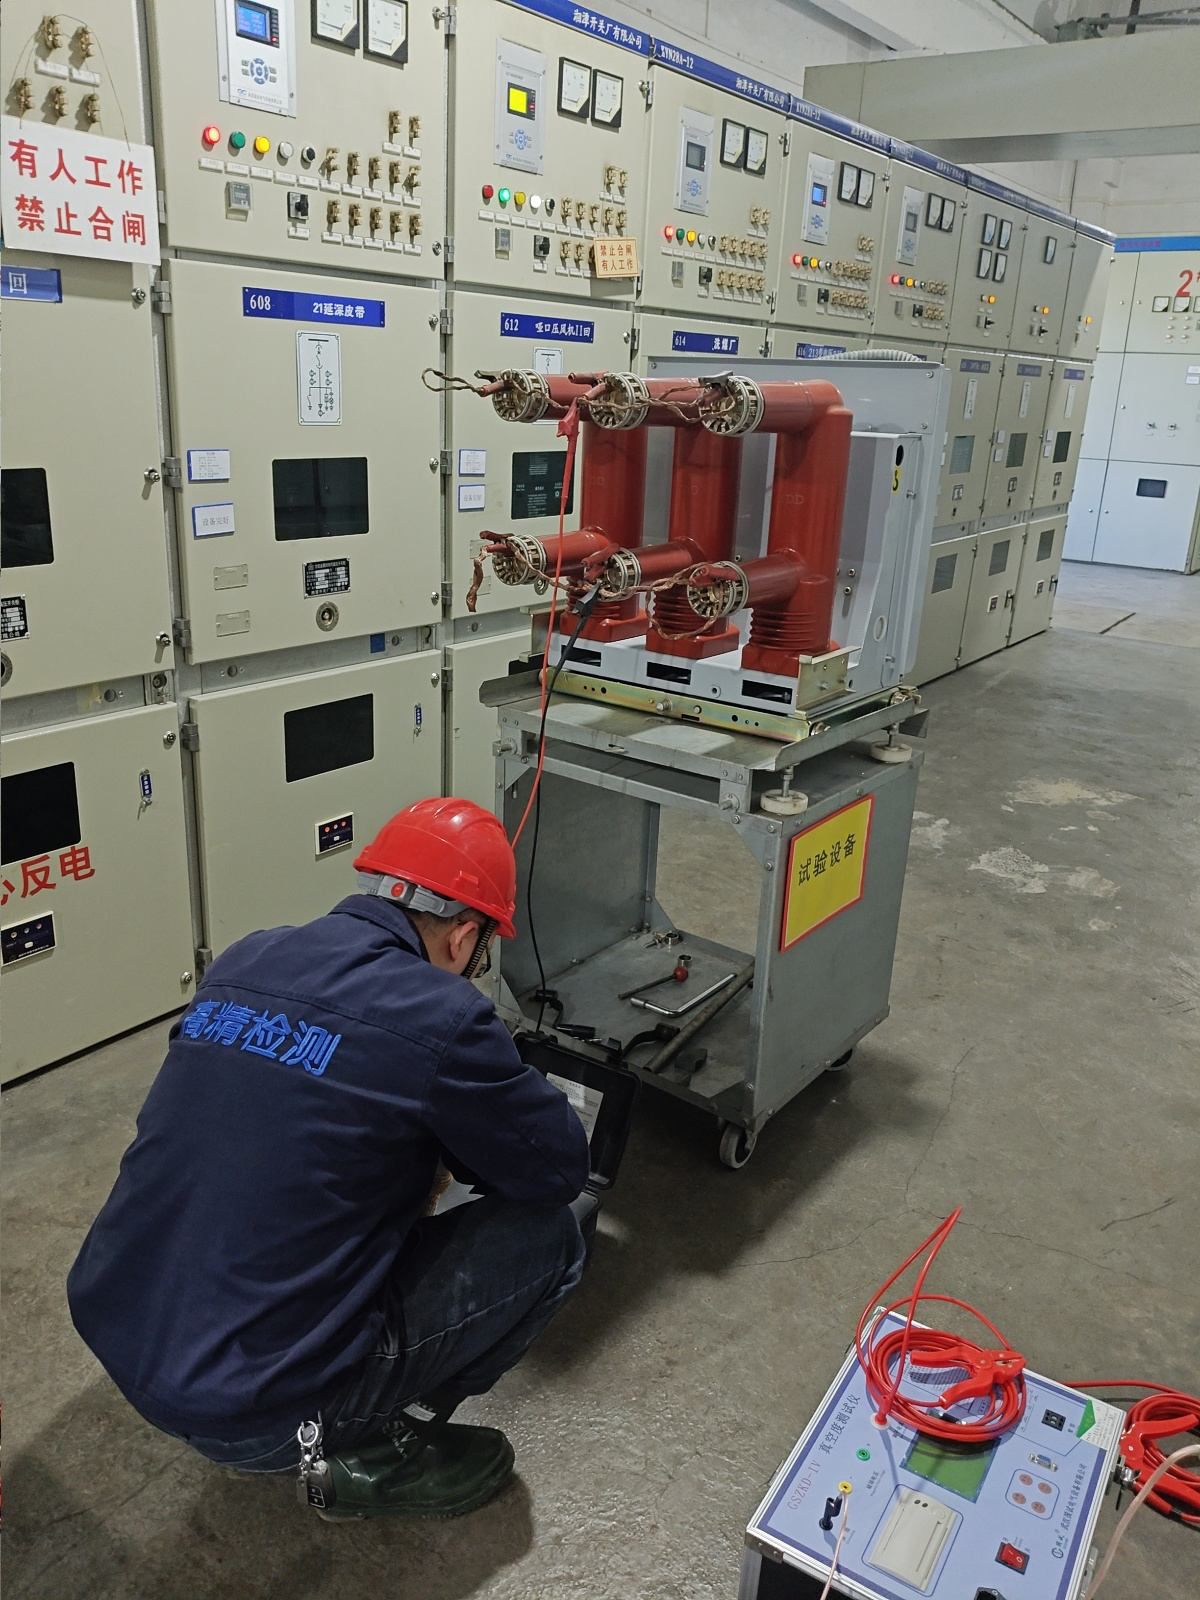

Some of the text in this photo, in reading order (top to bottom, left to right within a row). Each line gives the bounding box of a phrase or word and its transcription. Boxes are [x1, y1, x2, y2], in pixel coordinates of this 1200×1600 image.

[8, 138, 143, 196] 有人工作
[15, 193, 147, 245] 禁止合闸
[600, 245, 633, 258] 禁止合闸
[601, 258, 634, 272] 有人工作
[9, 272, 27, 294] 回
[1175, 269, 1200, 297] 2
[249, 295, 272, 312] 608
[312, 302, 366, 319] 21延深皮带
[504, 318, 519, 332] 612
[674, 335, 686, 347] 614
[798, 833, 856, 886] 试验设备
[818, 1393, 861, 1456] 真空度测试仪
